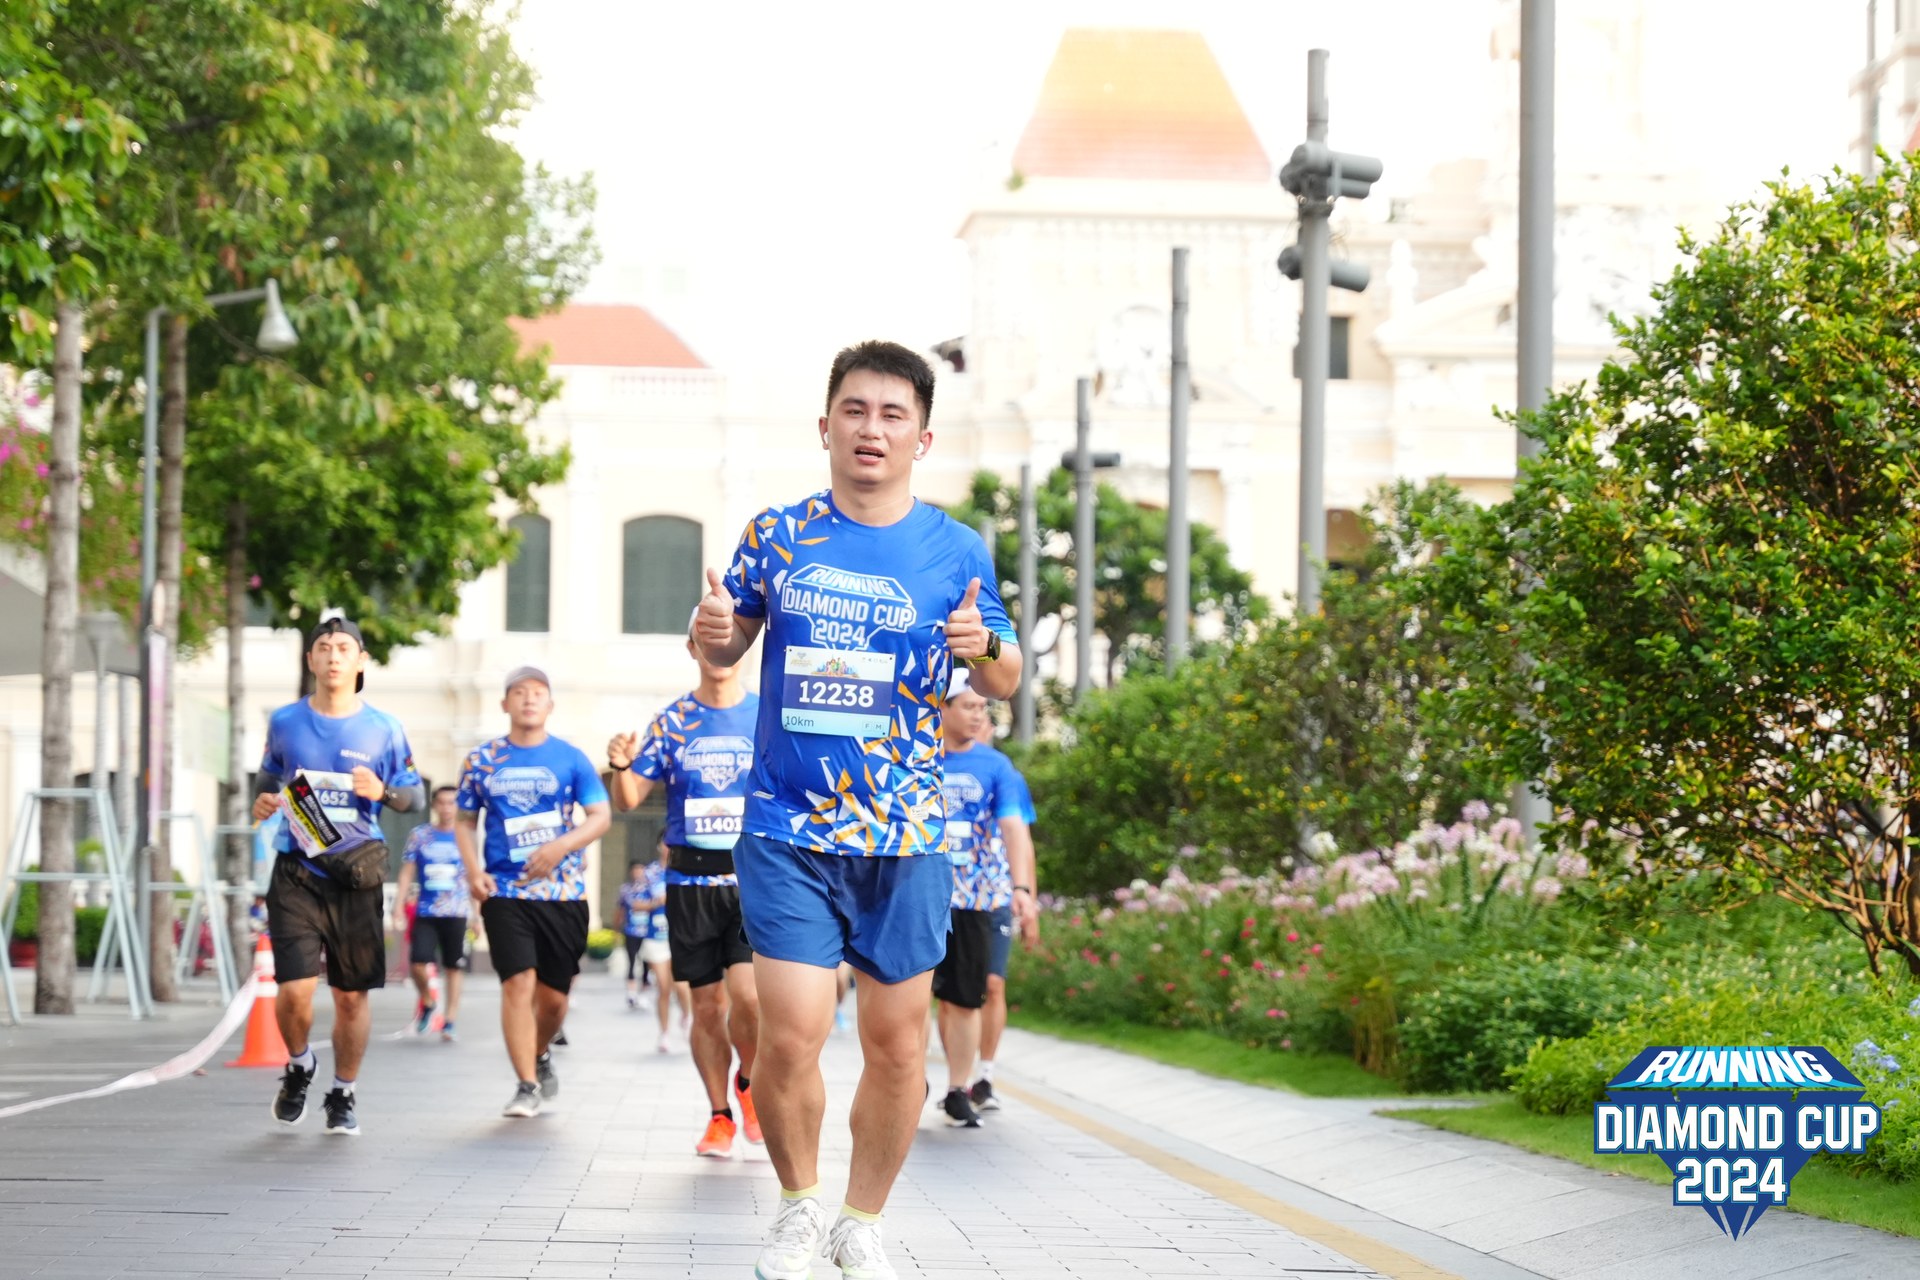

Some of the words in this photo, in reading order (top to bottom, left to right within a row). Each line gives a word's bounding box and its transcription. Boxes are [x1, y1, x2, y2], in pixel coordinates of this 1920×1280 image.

[803, 568, 896, 596] RUNNING
[784, 587, 869, 622] DIAMOND
[873, 604, 913, 628] CUP
[814, 618, 866, 646] 2024
[799, 680, 874, 707] 12238
[786, 715, 814, 727] 10km
[694, 817, 742, 833] 11401
